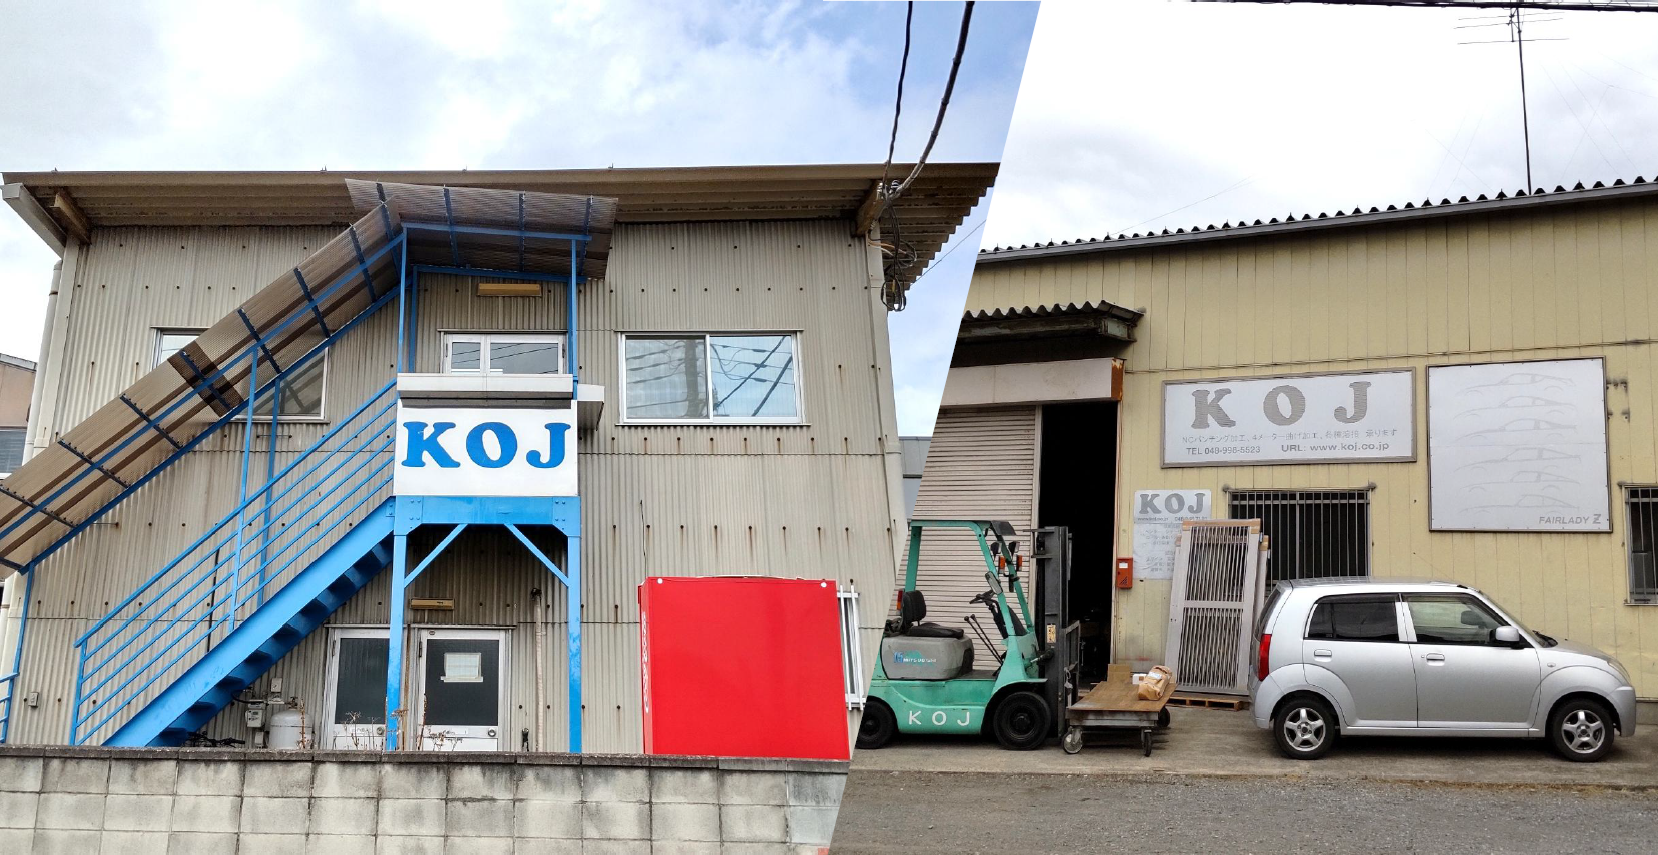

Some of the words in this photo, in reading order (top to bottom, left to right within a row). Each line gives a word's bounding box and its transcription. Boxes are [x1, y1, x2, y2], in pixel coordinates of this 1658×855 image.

[401, 421, 571, 468] KOJ
[1186, 447, 1202, 455] TEL
[1310, 442, 1390, 452] www.koj.co.jp
[1138, 492, 1206, 514] KOJ
[1539, 516, 1590, 525] FAIRLADY
[1592, 513, 1602, 525] Z
